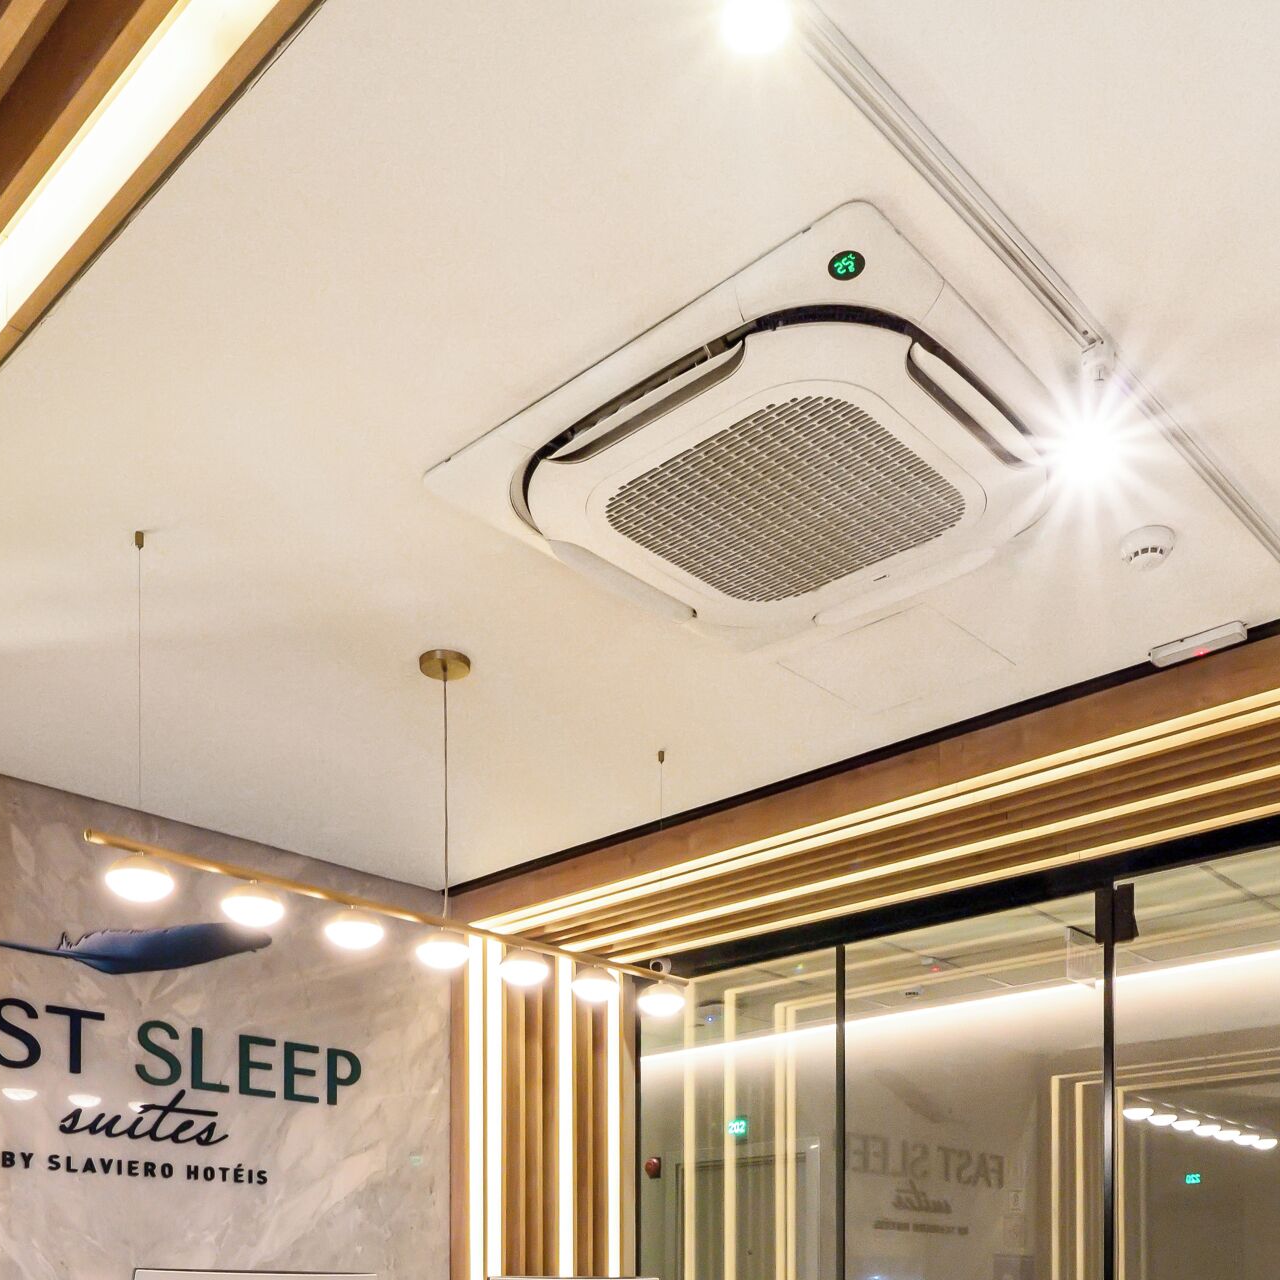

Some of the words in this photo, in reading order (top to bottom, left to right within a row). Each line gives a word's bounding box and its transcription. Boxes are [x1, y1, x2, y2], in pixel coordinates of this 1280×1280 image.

[135, 1020, 362, 1106] SLEEP
[1, 1151, 34, 1169] BY
[47, 1154, 174, 1179] SLAVIERO
[186, 1163, 268, 1185] HOTÉIS
